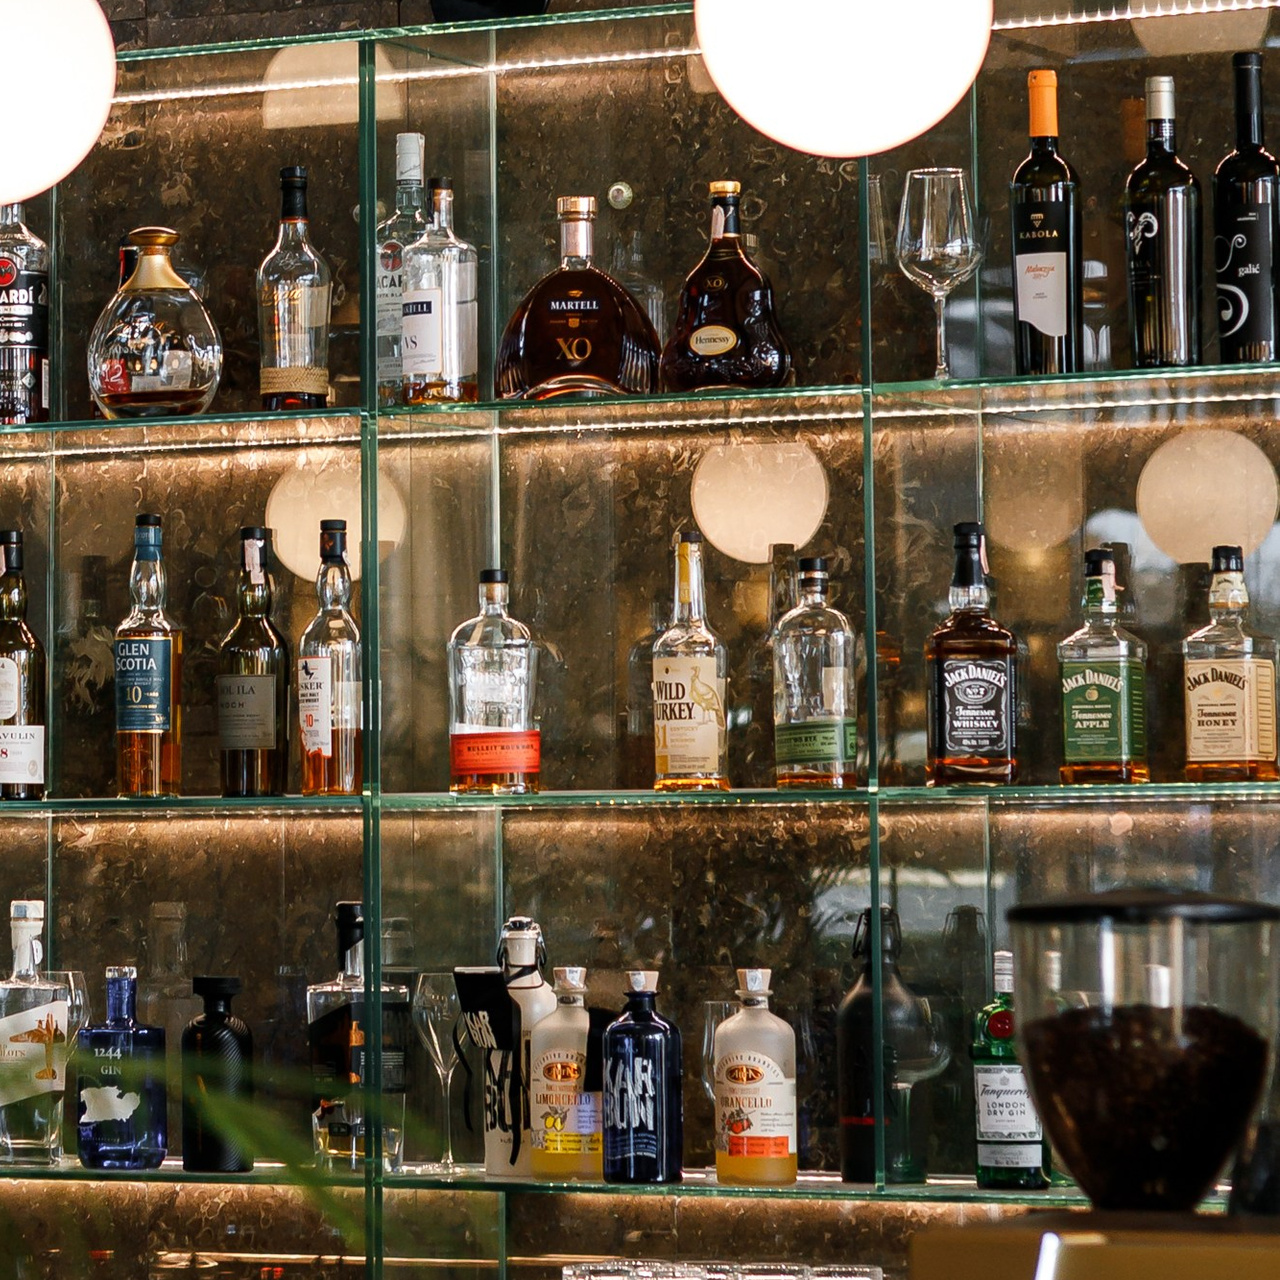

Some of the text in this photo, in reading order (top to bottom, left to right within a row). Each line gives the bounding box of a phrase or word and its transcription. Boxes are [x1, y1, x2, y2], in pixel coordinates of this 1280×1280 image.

[1019, 230, 1059, 240] KABOLA
[1238, 263, 1260, 277] galić
[550, 300, 599, 310] MARTELL
[695, 335, 730, 345] Hennessy
[555, 337, 593, 360] XO
[118, 642, 150, 657] GLEN
[116, 657, 157, 672] SCOTIA
[944, 664, 1008, 689] JACK DANIEL'S
[1062, 669, 1124, 694] JACK DANIEL'S
[1187, 667, 1248, 692] JACK DANIEL'S
[126, 685, 142, 704] 10
[655, 680, 686, 701] WILD
[655, 702, 695, 721] URKEY
[1071, 710, 1113, 720] Tennessee
[1197, 708, 1237, 718] Tennessee
[305, 714, 314, 728] 10
[952, 720, 1000, 729] WHISKEY
[1074, 720, 1110, 729] APPLE
[1197, 719, 1238, 727] HONEY
[0, 747, 9, 759] 8
[94, 1047, 122, 1060] 1244
[101, 1065, 122, 1076] GIN
[986, 1101, 1026, 1109] LONDON
